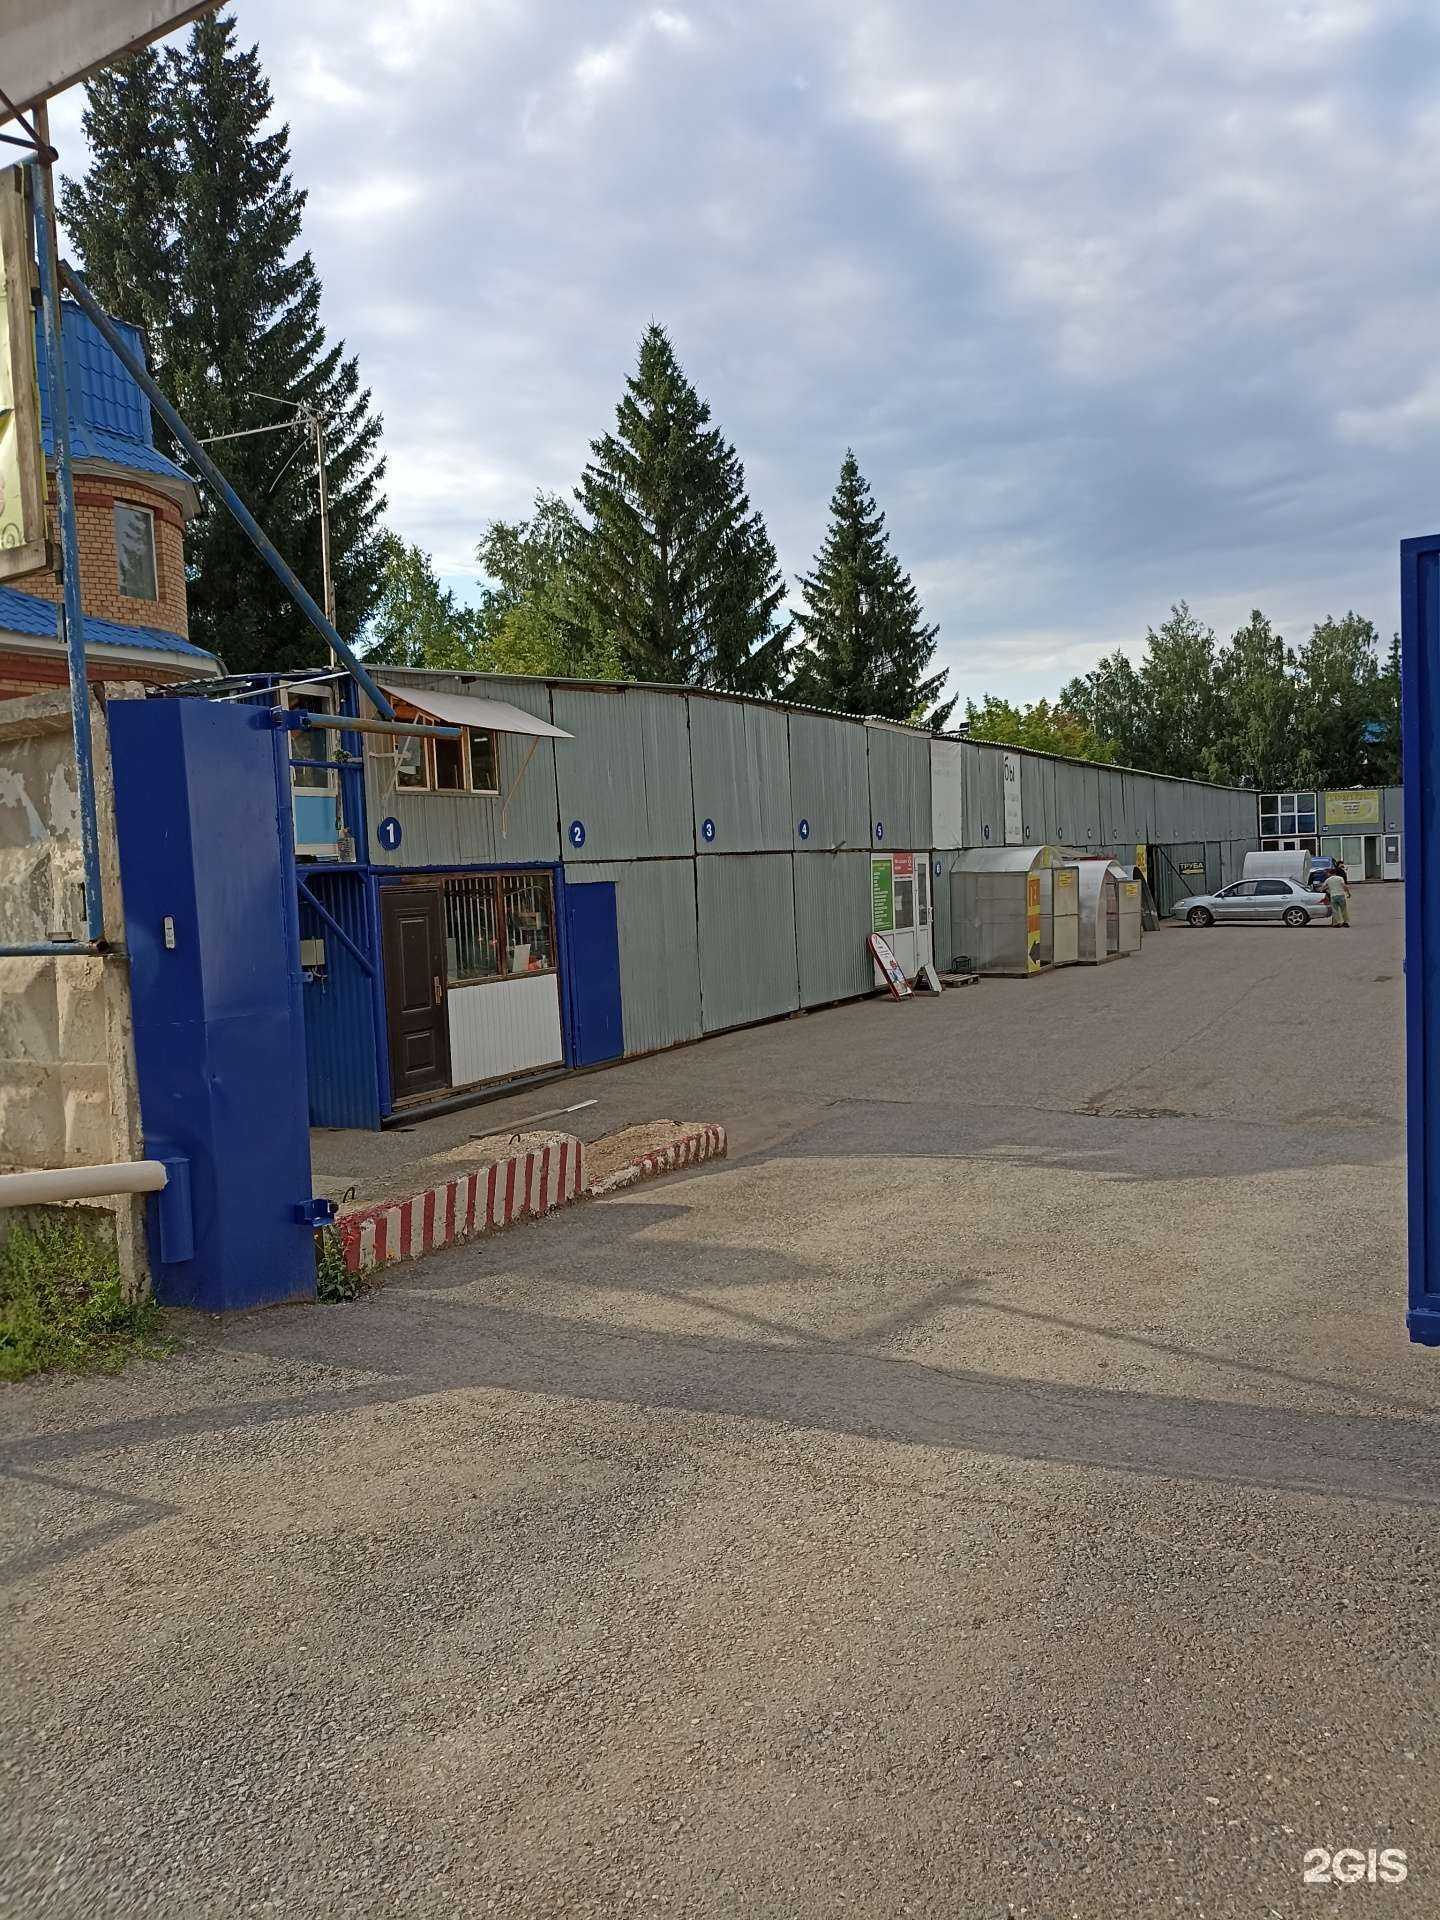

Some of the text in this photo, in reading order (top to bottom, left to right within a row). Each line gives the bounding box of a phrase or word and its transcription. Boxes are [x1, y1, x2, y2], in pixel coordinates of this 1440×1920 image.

[386, 823, 395, 843] 1
[574, 827, 582, 842] 2
[706, 824, 712, 838] 3
[802, 824, 807, 835] 4
